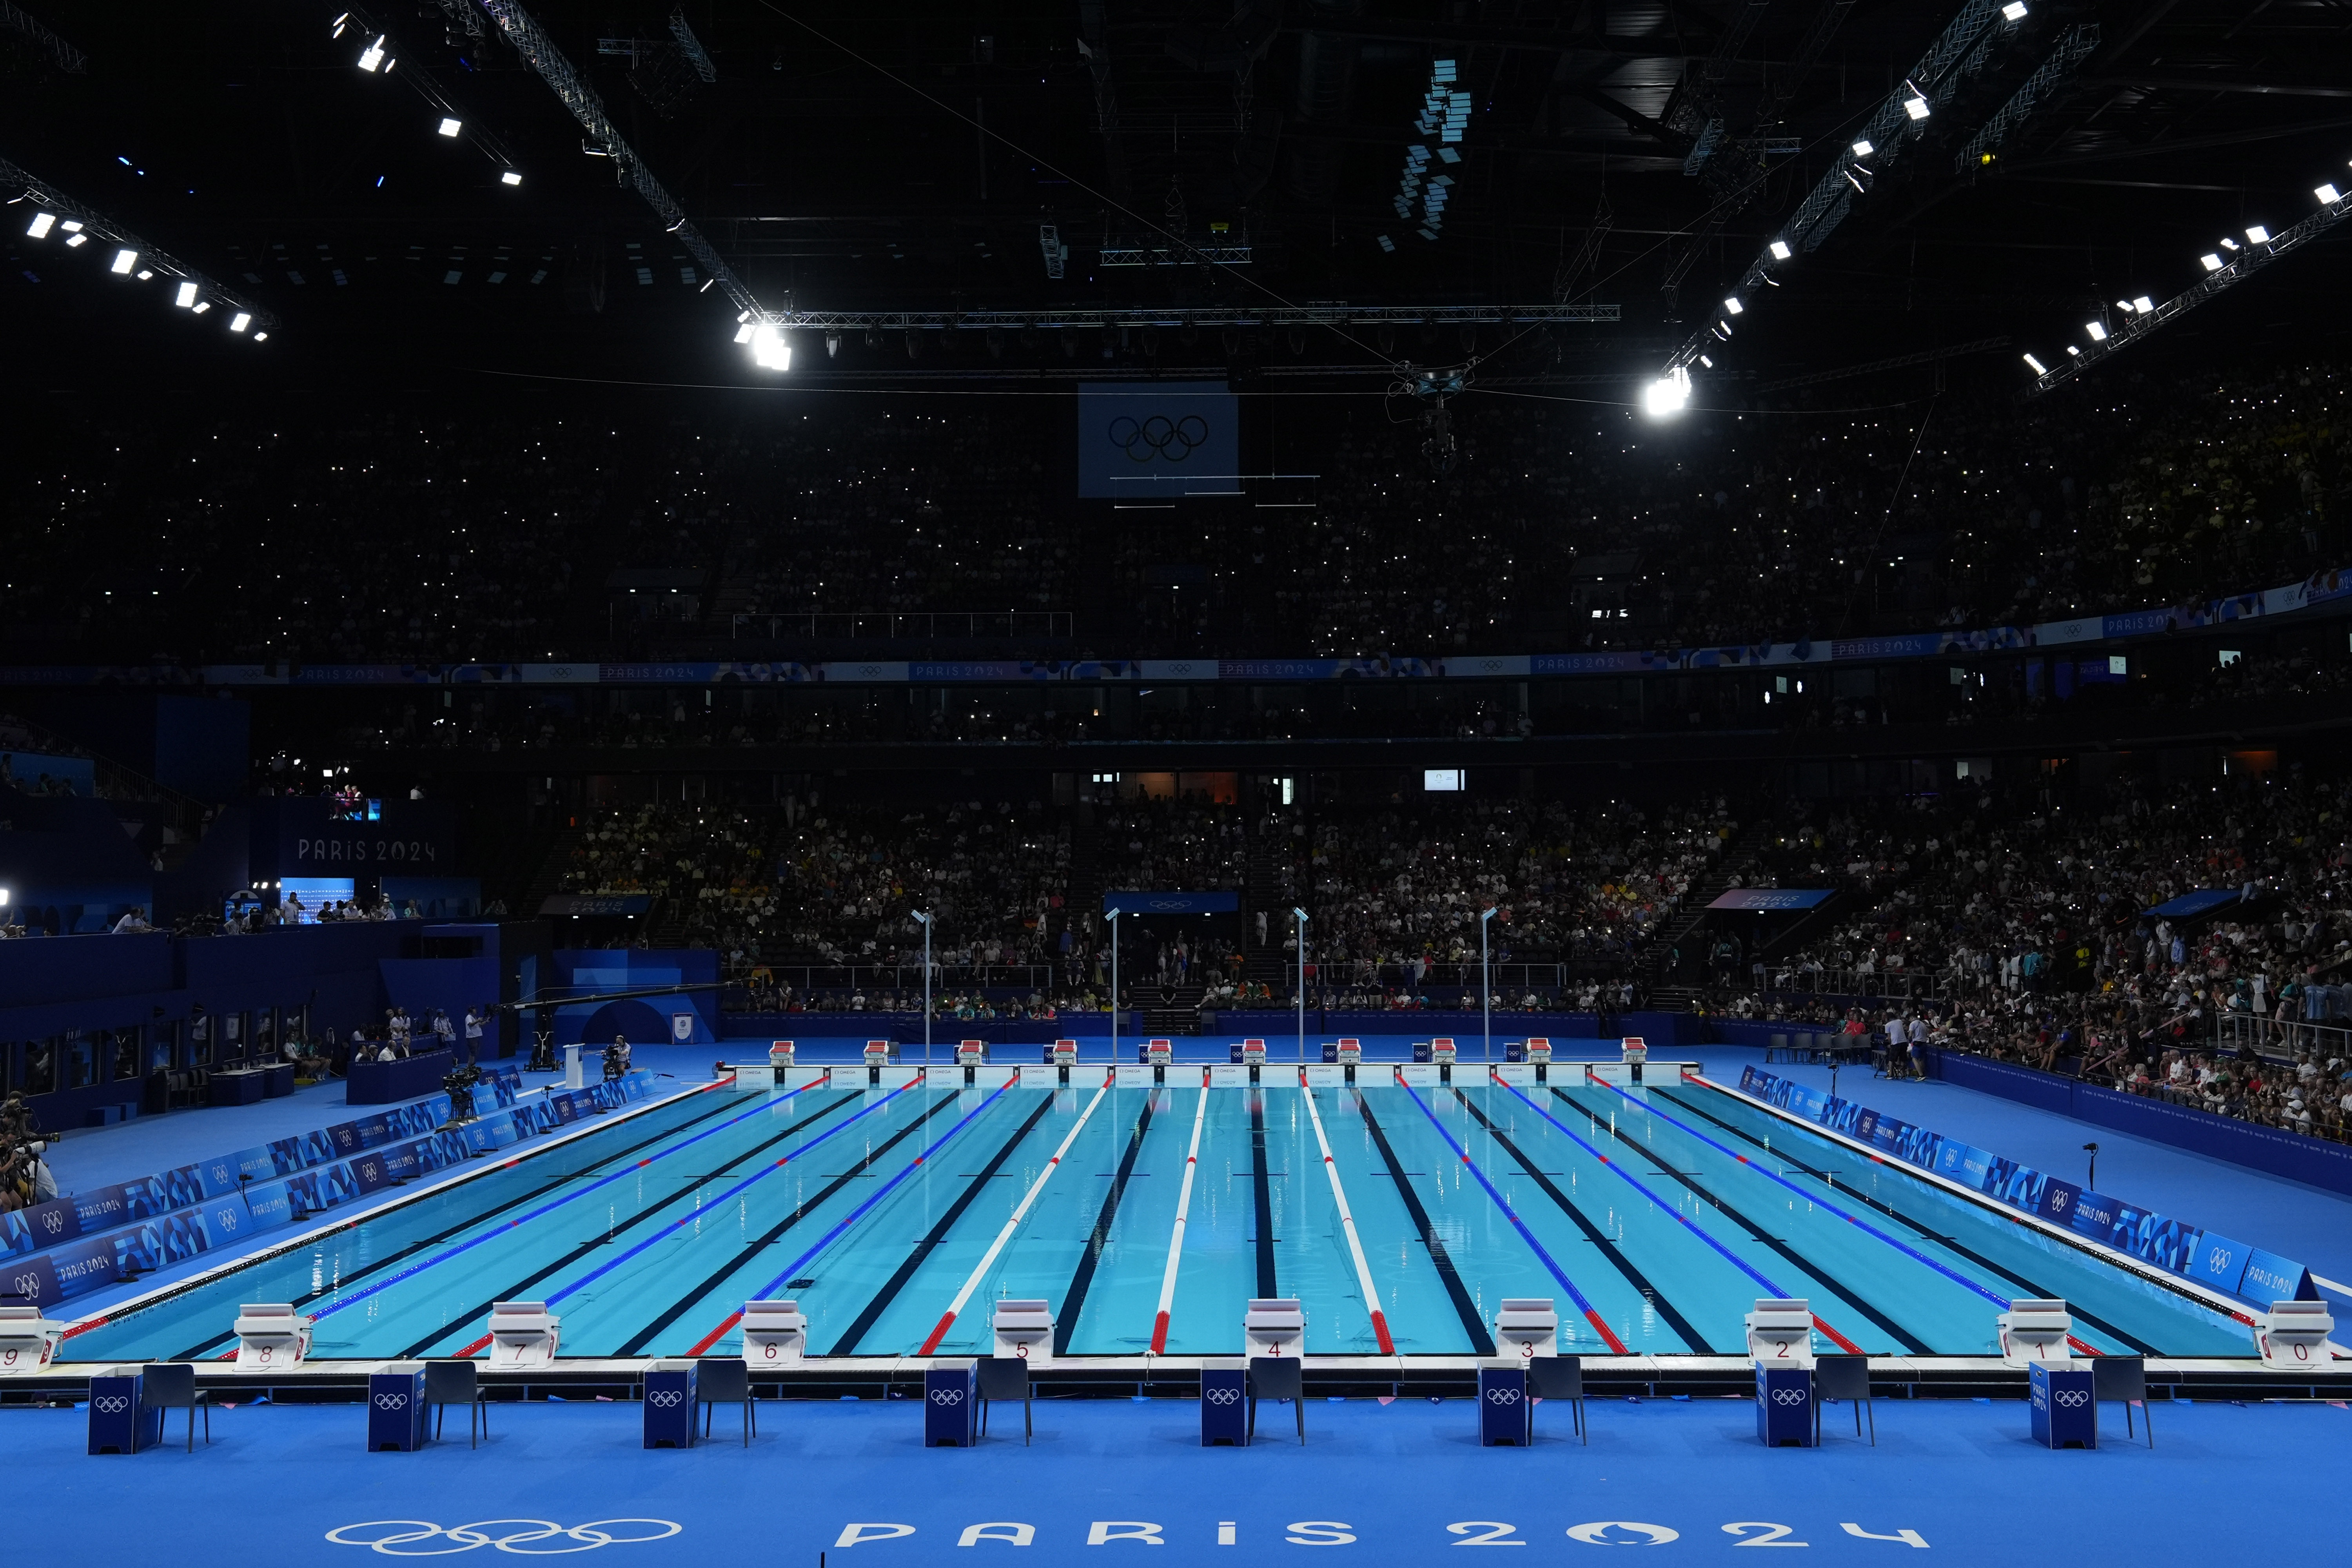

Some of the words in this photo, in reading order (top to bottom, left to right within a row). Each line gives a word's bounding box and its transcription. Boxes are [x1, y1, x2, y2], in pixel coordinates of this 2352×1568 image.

[1885, 640, 1921, 652] 2024
[965, 666, 1003, 675] 2024
[1275, 664, 1313, 674] 2024
[1586, 657, 1624, 668] 2024
[346, 670, 383, 679] 2024
[655, 668, 693, 677] 2024
[376, 841, 435, 861] 2024
[102, 1200, 121, 1214] 2024
[2094, 1209, 2111, 1225] 2024
[87, 1256, 109, 1272] 2024
[2272, 1275, 2293, 1295] 2024
[4, 1348, 18, 1365] 9
[44, 1345, 49, 1359] 9
[259, 1346, 272, 1363] 8
[298, 1342, 302, 1356] 8
[514, 1344, 526, 1360] 7
[765, 1342, 777, 1359] 6
[1016, 1342, 1029, 1358] 5
[1269, 1341, 1281, 1357] 4
[1522, 1341, 1534, 1357] 3
[1776, 1341, 1789, 1357] 2
[2035, 1342, 2045, 1359] 1
[2294, 1343, 2308, 1360] 0
[2033, 1396, 2046, 1412] 2024
[1446, 1521, 1931, 1548] 2024
